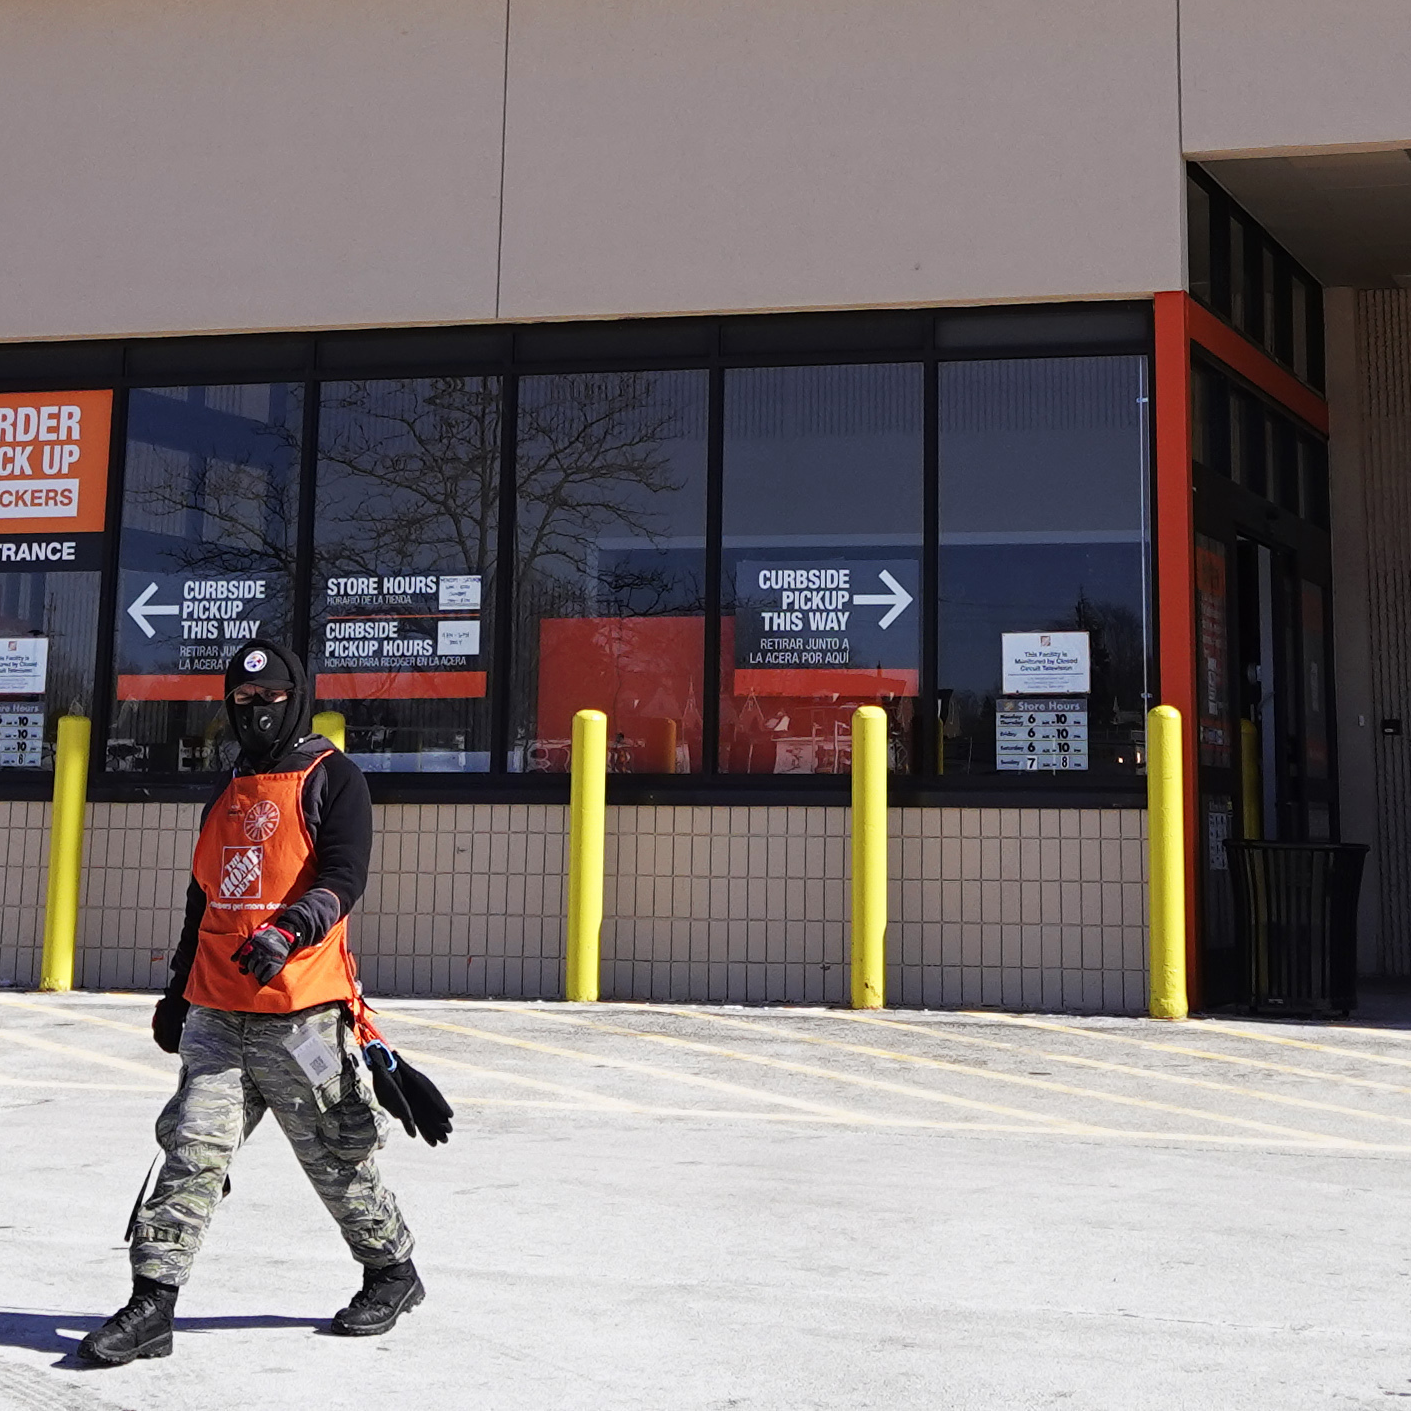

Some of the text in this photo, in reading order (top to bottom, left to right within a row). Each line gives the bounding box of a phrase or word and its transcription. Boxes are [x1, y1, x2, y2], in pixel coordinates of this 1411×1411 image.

[42, 445, 80, 475] UP
[327, 576, 436, 595] STORE HOURS
[759, 569, 850, 589] CURBSIDE
[184, 580, 265, 599] CURBSIDE
[327, 595, 412, 605] HORARIO DE LA TIENDA
[782, 591, 850, 610] PICKUP
[182, 600, 243, 619] PICKUP
[761, 612, 849, 631] THIS WAY
[181, 619, 261, 639] THIS WAY
[326, 621, 398, 639] CURBSIDE
[325, 640, 433, 657] PICKUP HOURS
[760, 637, 850, 650] RETIRAR JUNTO A
[179, 646, 218, 657] RETIRAR
[749, 649, 849, 665] LA ACERA POR AQUÍ
[1039, 651, 1060, 659] Facility
[178, 659, 191, 670] LA
[193, 659, 223, 670] ACERA
[325, 656, 466, 667] HORARIO PARA RECOGER EN LA ACERA
[12, 703, 39, 712] Hours
[1018, 702, 1080, 711] Store Hours
[18, 716, 28, 726] 10
[1027, 713, 1036, 724] 6
[1055, 714, 1067, 724] 10
[18, 729, 28, 739] 10
[1027, 728, 1036, 738] 6
[1056, 728, 1069, 739] 10
[17, 741, 27, 751] 10
[1027, 742, 1036, 752] 6
[1057, 742, 1070, 753] 10
[1027, 757, 1036, 769] 7
[1061, 756, 1068, 768] 8
[221, 847, 262, 897] HOME
